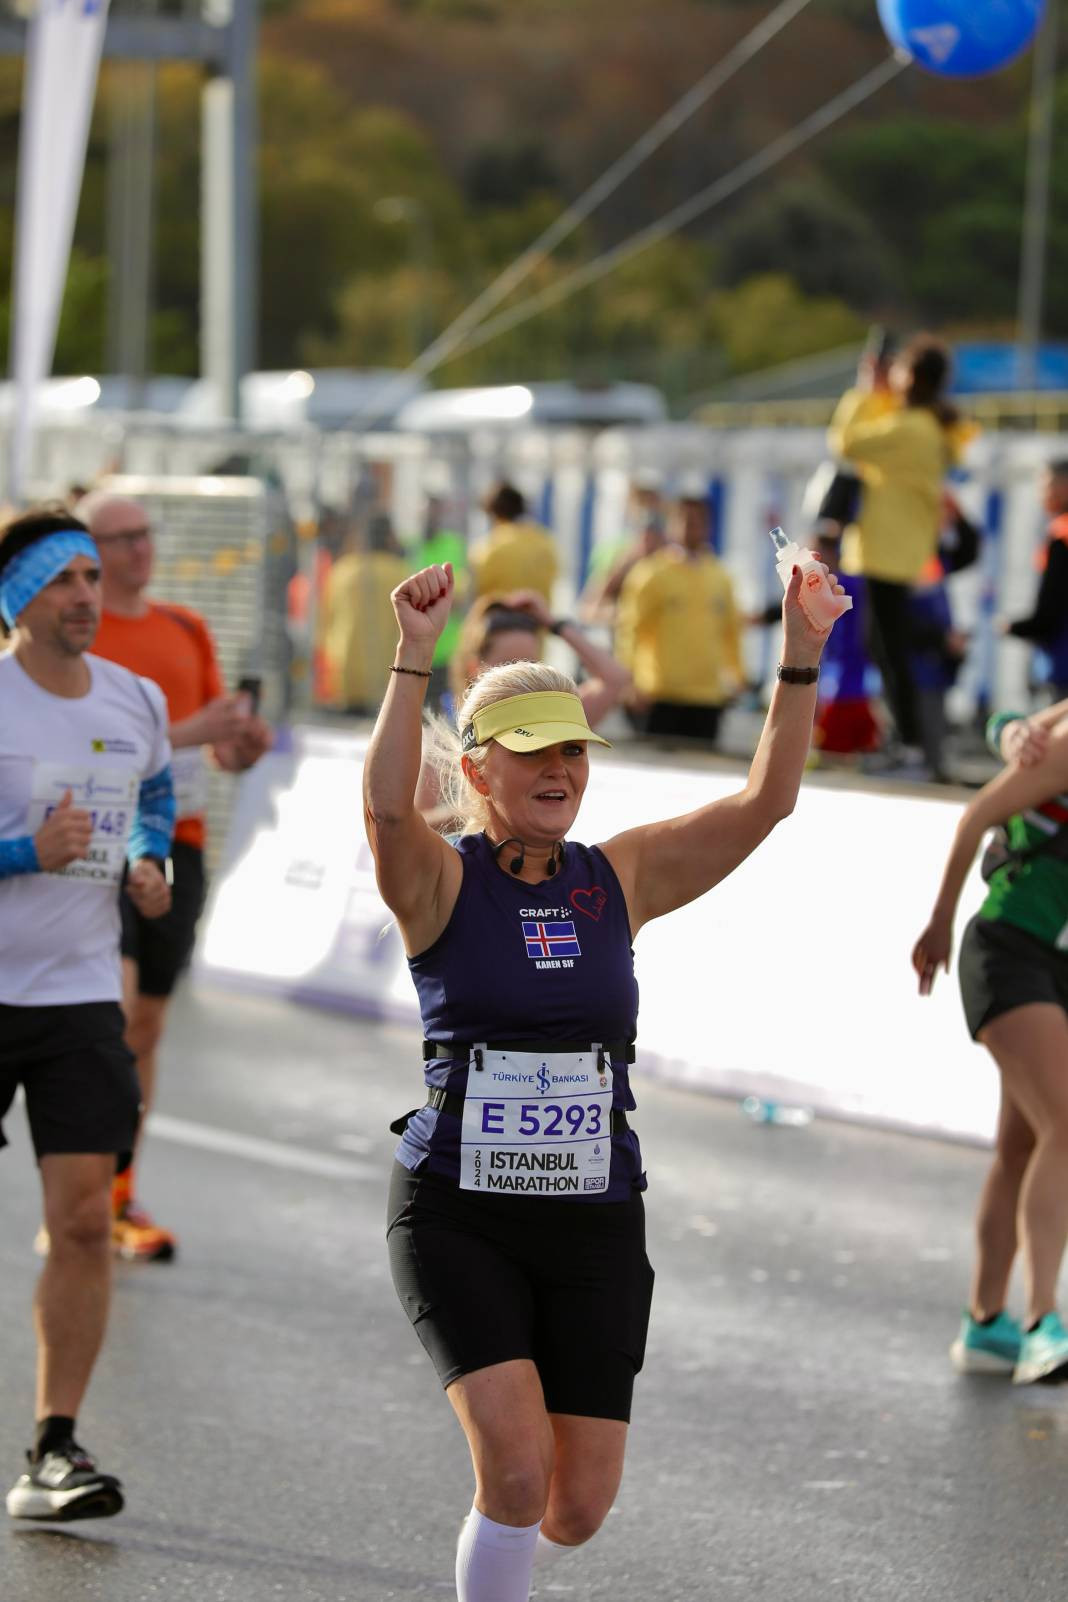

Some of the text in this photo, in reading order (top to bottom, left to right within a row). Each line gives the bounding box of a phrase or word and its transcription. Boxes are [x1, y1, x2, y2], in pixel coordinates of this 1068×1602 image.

[519, 908, 559, 917] CRAFT
[535, 959, 574, 970] KAREN SIF
[492, 1071, 535, 1083] TÜRKİYE
[552, 1074, 589, 1083] BANKASI
[481, 1102, 602, 1136] E 5293
[490, 1151, 578, 1171] ISTANBUL
[487, 1174, 579, 1192] MARATHON
